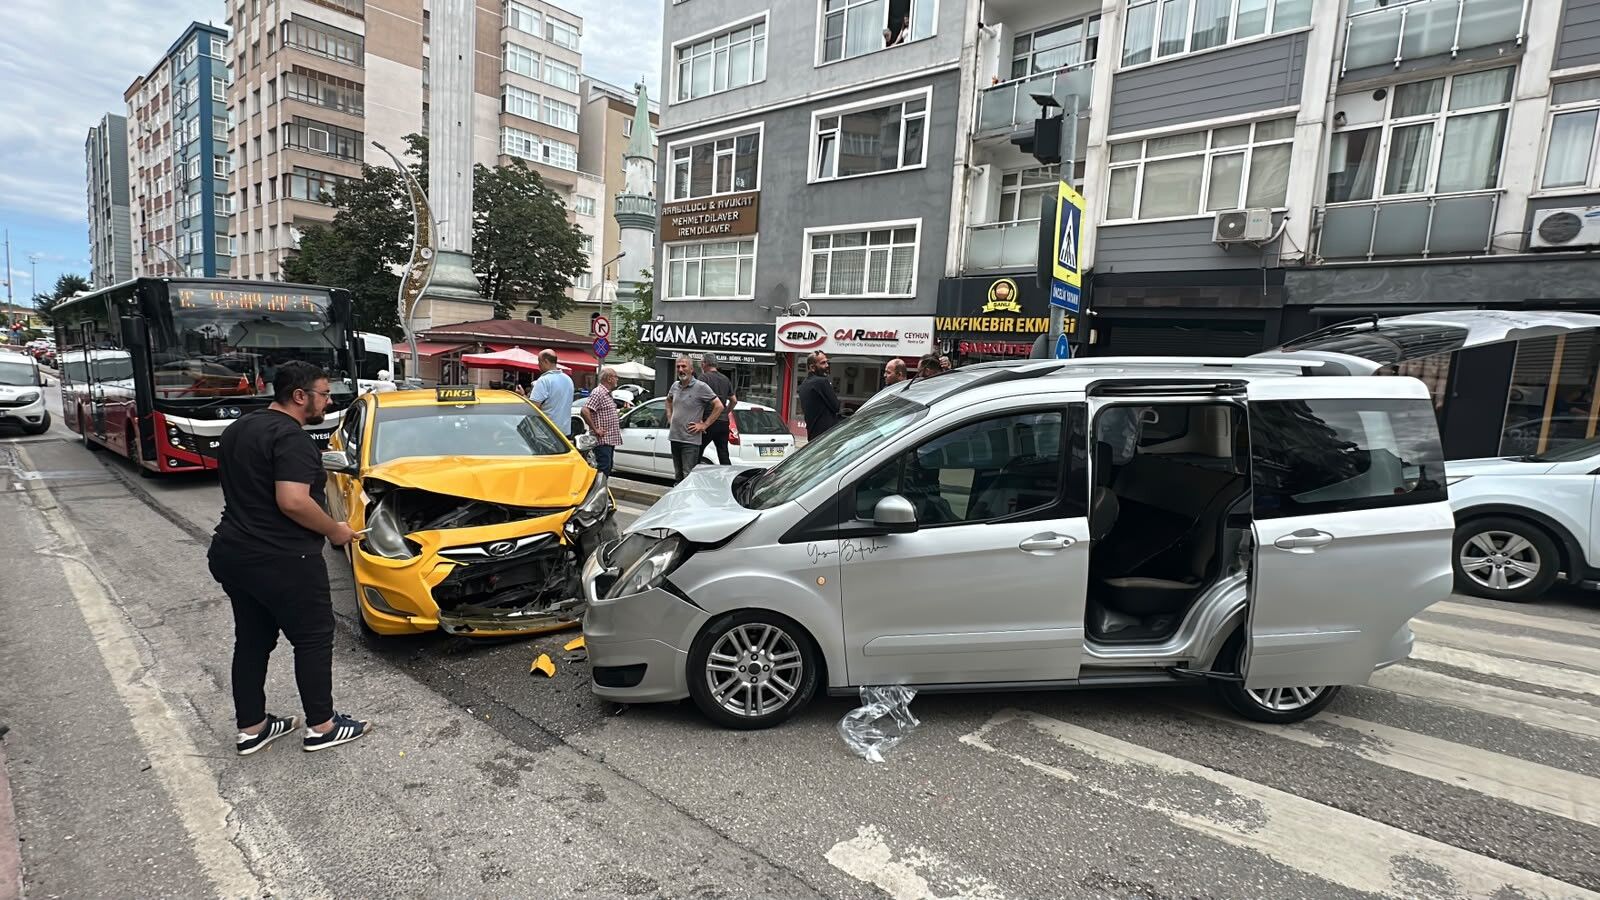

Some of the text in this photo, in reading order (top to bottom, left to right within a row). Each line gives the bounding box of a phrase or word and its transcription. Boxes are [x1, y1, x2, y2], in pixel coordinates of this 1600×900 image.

[672, 214, 704, 226] MEHMET
[1016, 315, 1076, 333] EKMĞİ
[904, 332, 930, 340] CEYHUN
